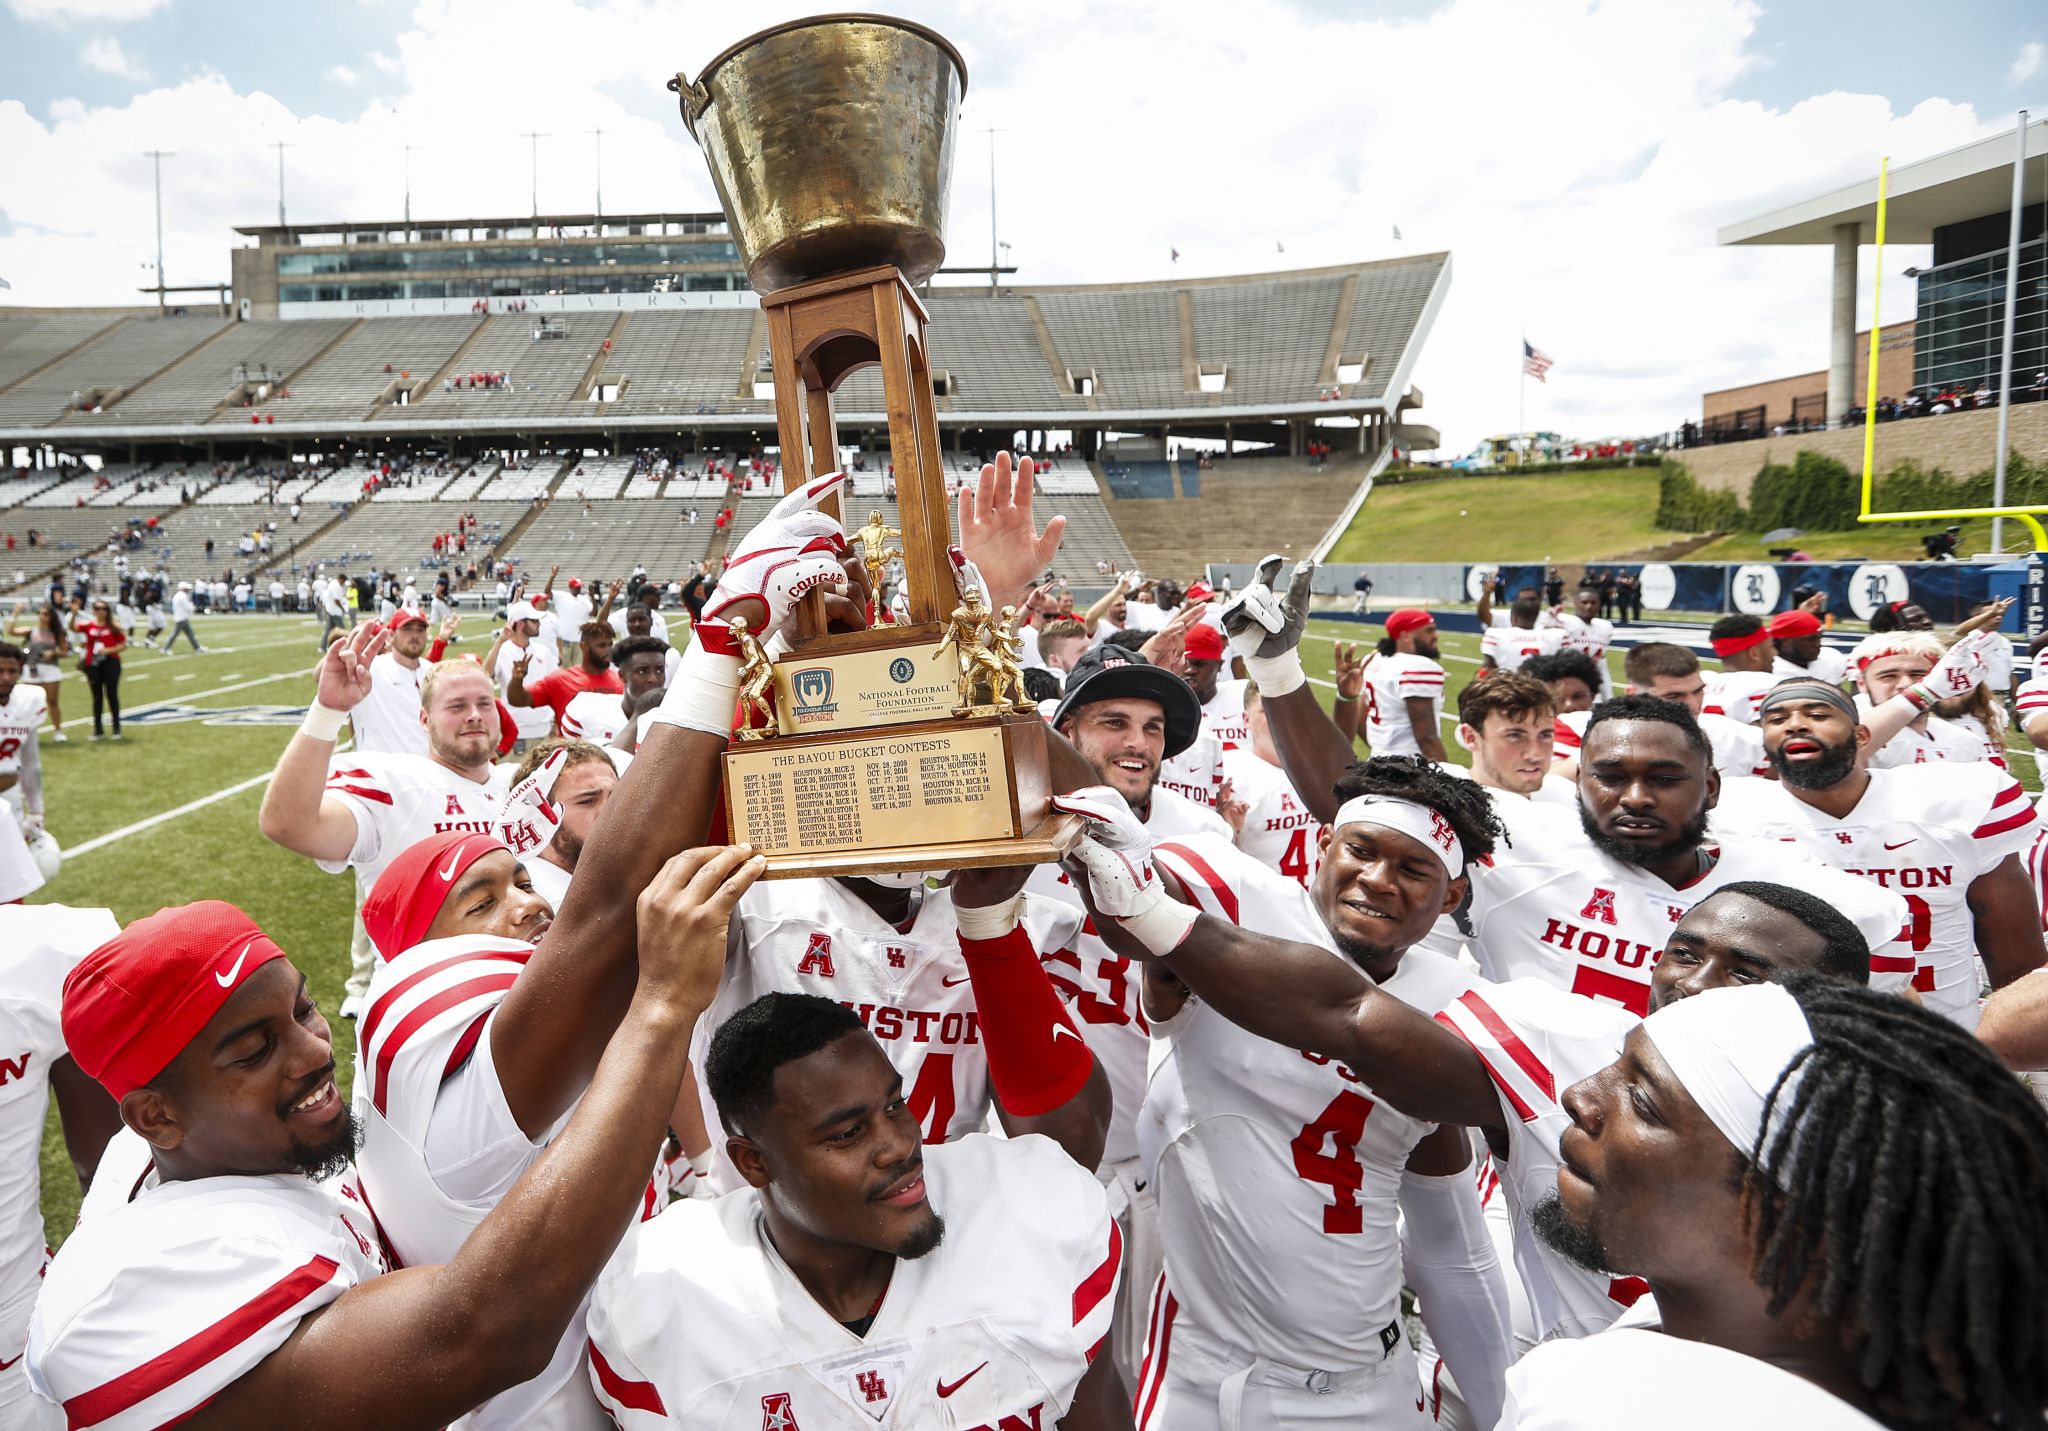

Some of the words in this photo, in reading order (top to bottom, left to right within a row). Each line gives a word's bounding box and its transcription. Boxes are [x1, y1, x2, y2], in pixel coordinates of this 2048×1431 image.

[355, 300, 450, 313] RICE
[498, 293, 745, 310] UNIVERSIT
[788, 573, 845, 598] COUGAR
[2027, 568, 2044, 640] RICE
[859, 690, 904, 700] NATIONAL
[906, 685, 952, 696] FOOTBALL
[876, 696, 934, 708] FOUNDATION
[802, 714, 830, 722] HOUSTON
[772, 756, 795, 766] THE
[798, 752, 836, 764] BAYOU
[838, 746, 886, 760] BUCKET
[888, 740, 951, 754] CONTESTS
[919, 756, 950, 765] HOUSTON
[962, 753, 978, 761] RICE
[947, 761, 978, 770] HOUSTON
[792, 768, 822, 778] HOUSTON
[834, 766, 850, 774] RICE
[920, 771, 948, 780] HOUSTON
[818, 774, 847, 783] HOUSTON
[922, 780, 955, 789] HOUSTON
[819, 782, 848, 790] HOUSTON
[794, 792, 824, 800] HOUSTON
[924, 788, 953, 797] HOUSTON
[796, 800, 824, 808] HOUSTON
[924, 797, 953, 806] HOUSTON
[823, 806, 854, 814] HOUSTON
[798, 816, 826, 824] HOUSTON
[798, 824, 827, 832] HOUSTON
[1428, 807, 1457, 853] UH
[501, 818, 544, 857] UH
[799, 831, 828, 839] HOUSTON
[825, 836, 854, 845] HOUSTON
[1279, 826, 1323, 892] 4
[1580, 887, 1617, 926] A
[798, 932, 835, 977] A
[886, 946, 906, 969] UH
[1290, 1089, 1375, 1233] 4
[856, 1370, 888, 1403] UH
